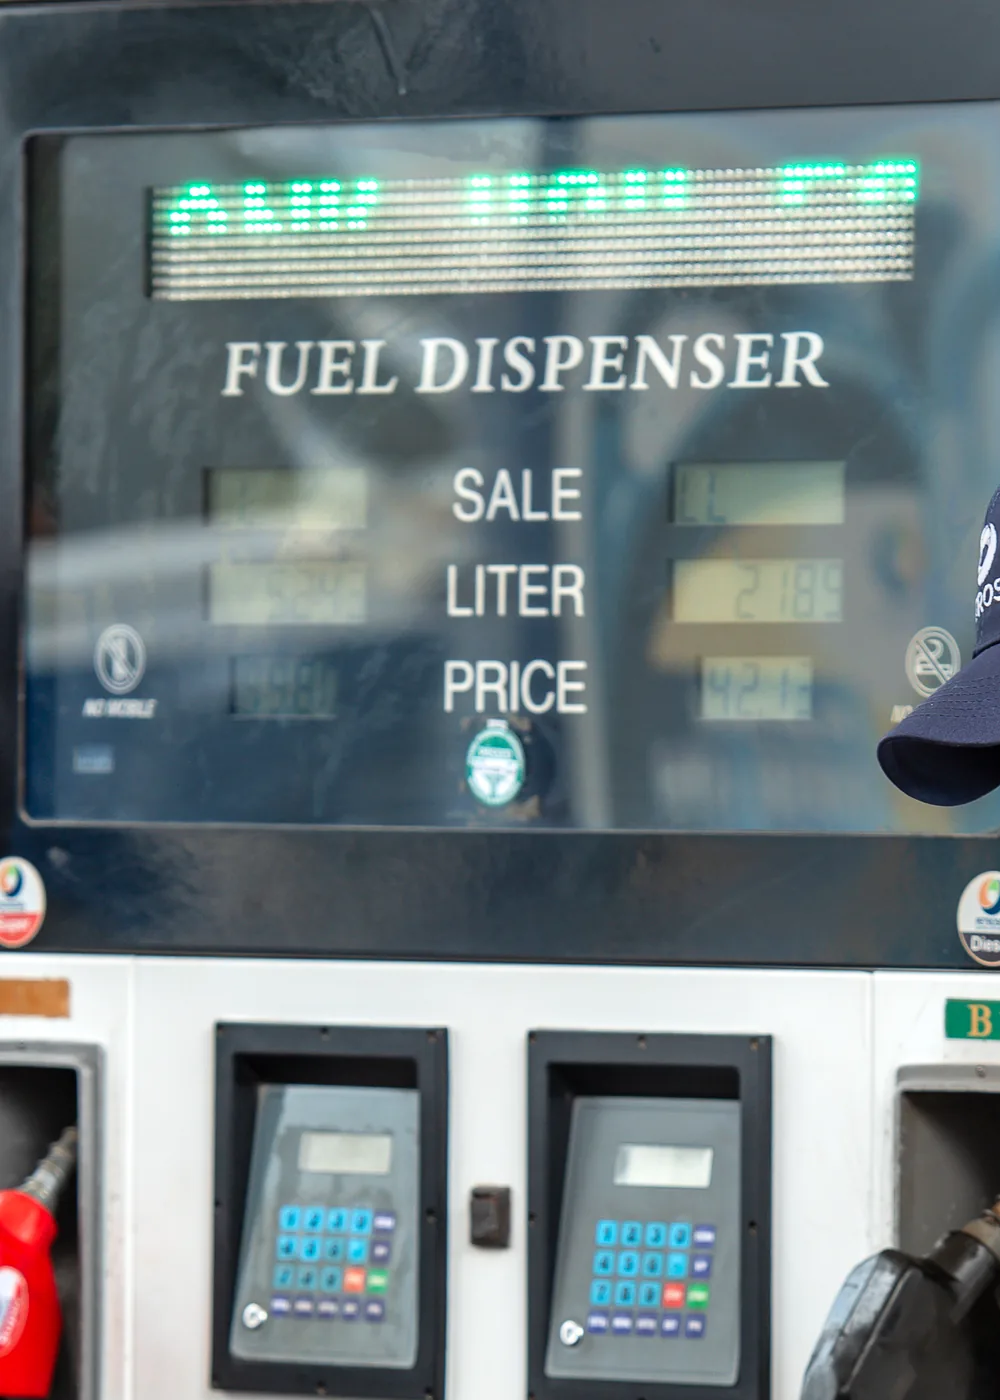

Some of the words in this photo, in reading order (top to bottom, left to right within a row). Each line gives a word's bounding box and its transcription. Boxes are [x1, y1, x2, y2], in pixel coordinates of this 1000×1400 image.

[221, 339, 399, 397] FUEL
[415, 330, 830, 395] DISPENSER
[452, 466, 583, 523] SALE
[446, 563, 586, 618] LITER
[443, 659, 588, 715] PRICE
